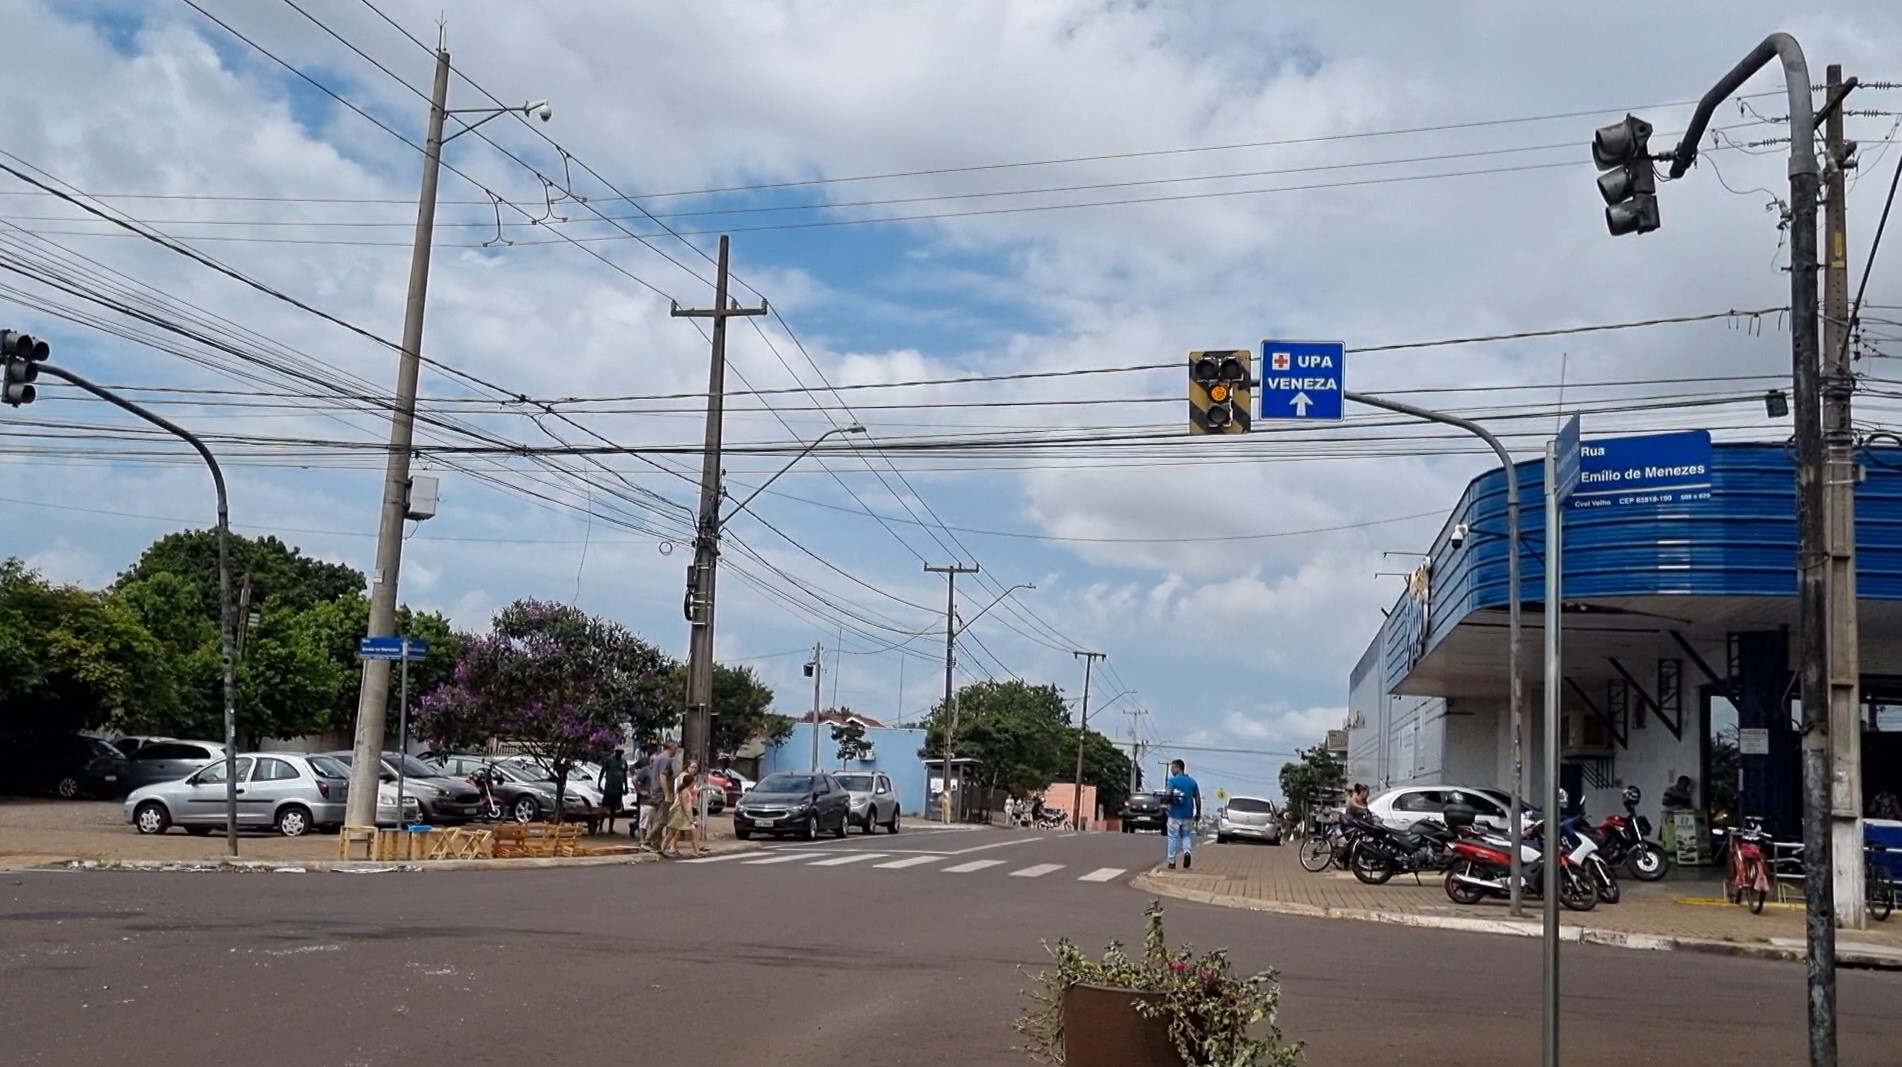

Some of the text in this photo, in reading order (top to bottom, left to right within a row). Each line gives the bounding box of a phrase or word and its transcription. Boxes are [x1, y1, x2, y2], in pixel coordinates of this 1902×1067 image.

[1298, 356, 1333, 367] UPA
[1267, 377, 1338, 390] VENEZA
[1580, 446, 1605, 457] Rua
[1581, 465, 1705, 483] Emílio de Menezes
[1618, 497, 1635, 505] CEP
